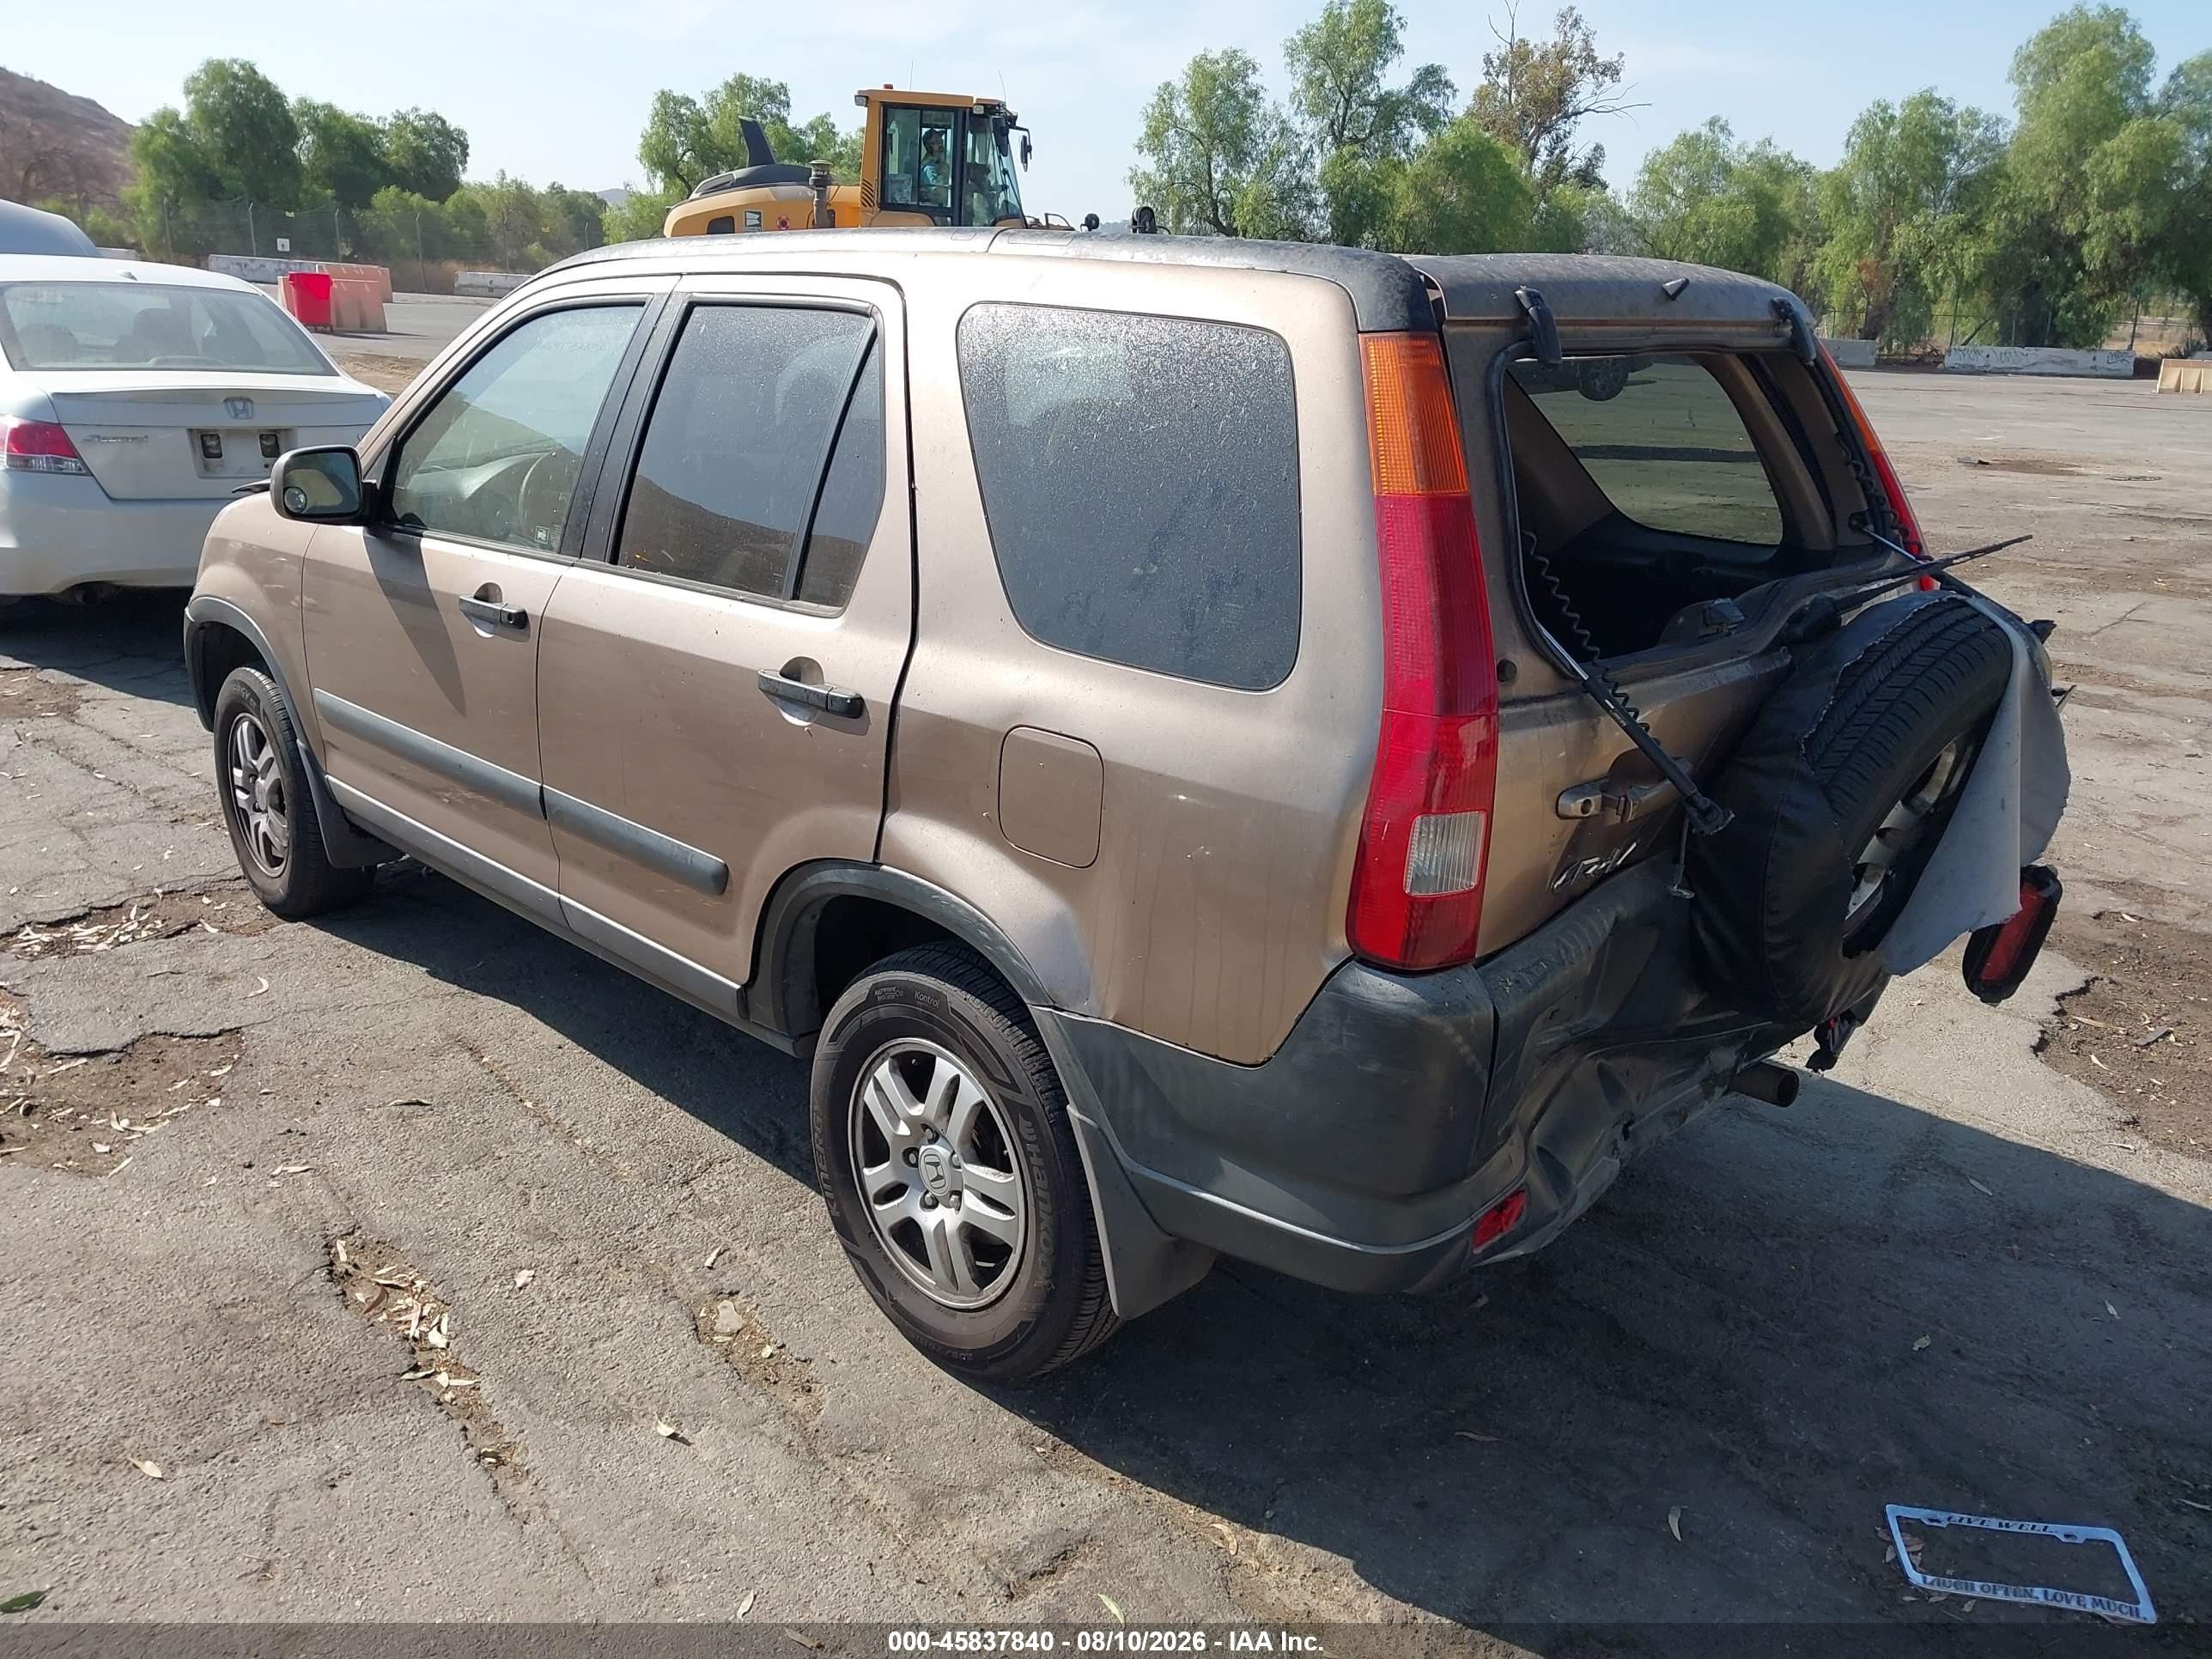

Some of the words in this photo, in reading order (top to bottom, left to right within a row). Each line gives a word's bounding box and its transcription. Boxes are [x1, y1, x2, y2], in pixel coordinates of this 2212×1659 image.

[812, 1105, 841, 1217] KINERG
[1947, 1516, 1991, 1527] LIVE
[1922, 1575, 1976, 1592] LAUGH
[2044, 1589, 2087, 1608] LOVE
